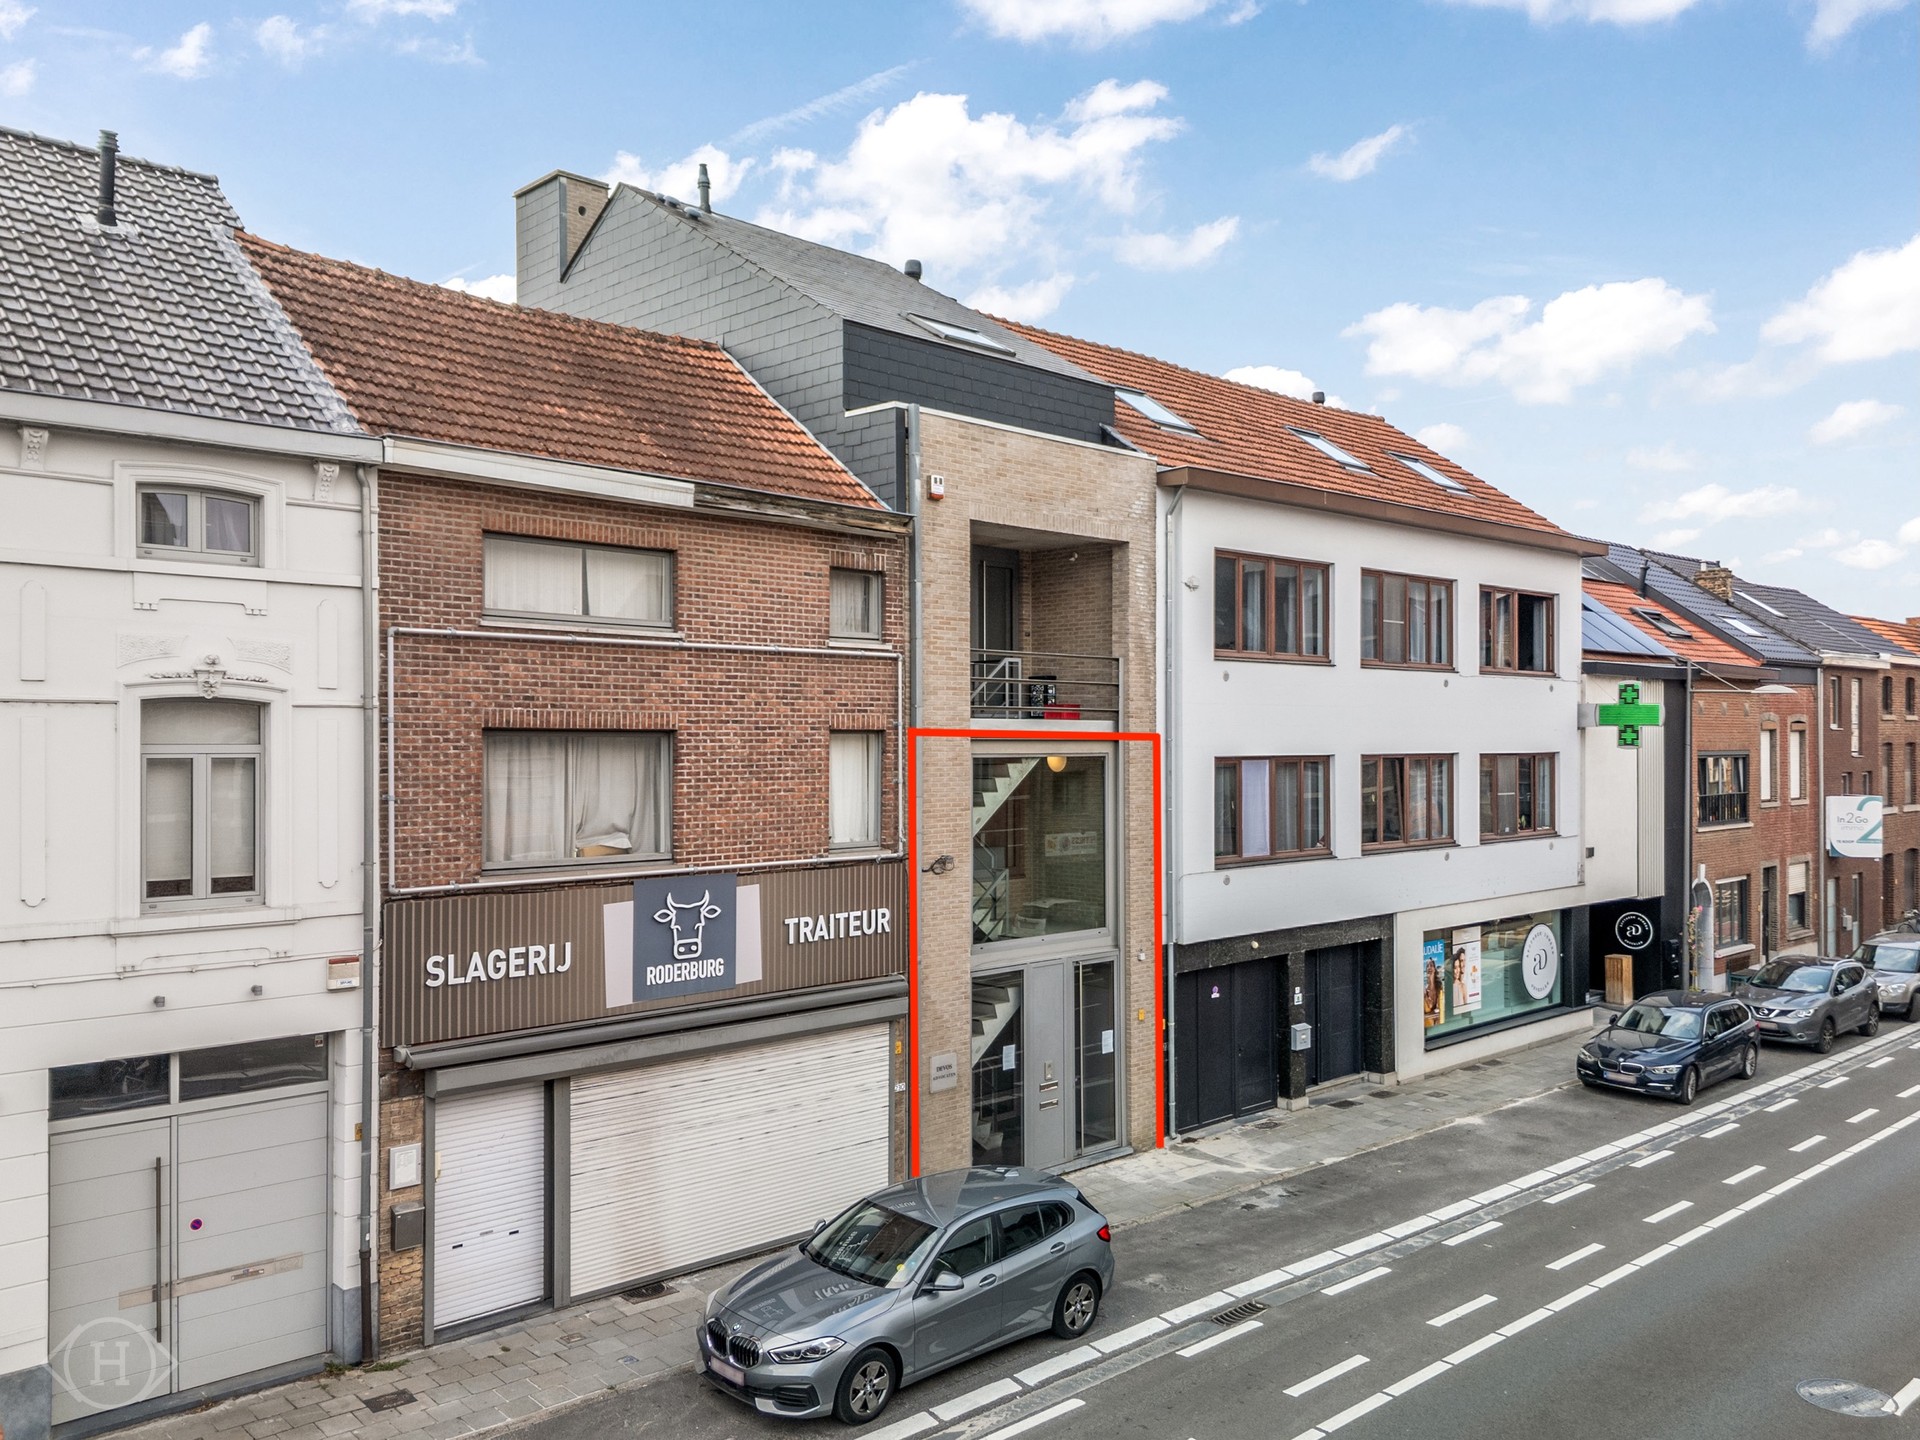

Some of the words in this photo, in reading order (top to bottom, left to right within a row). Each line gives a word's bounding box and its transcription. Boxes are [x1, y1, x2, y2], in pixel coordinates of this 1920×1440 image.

[784, 907, 890, 945] TRAITEUR
[425, 941, 571, 988] SLAGERIJ
[646, 957, 725, 986] RODERBURG
